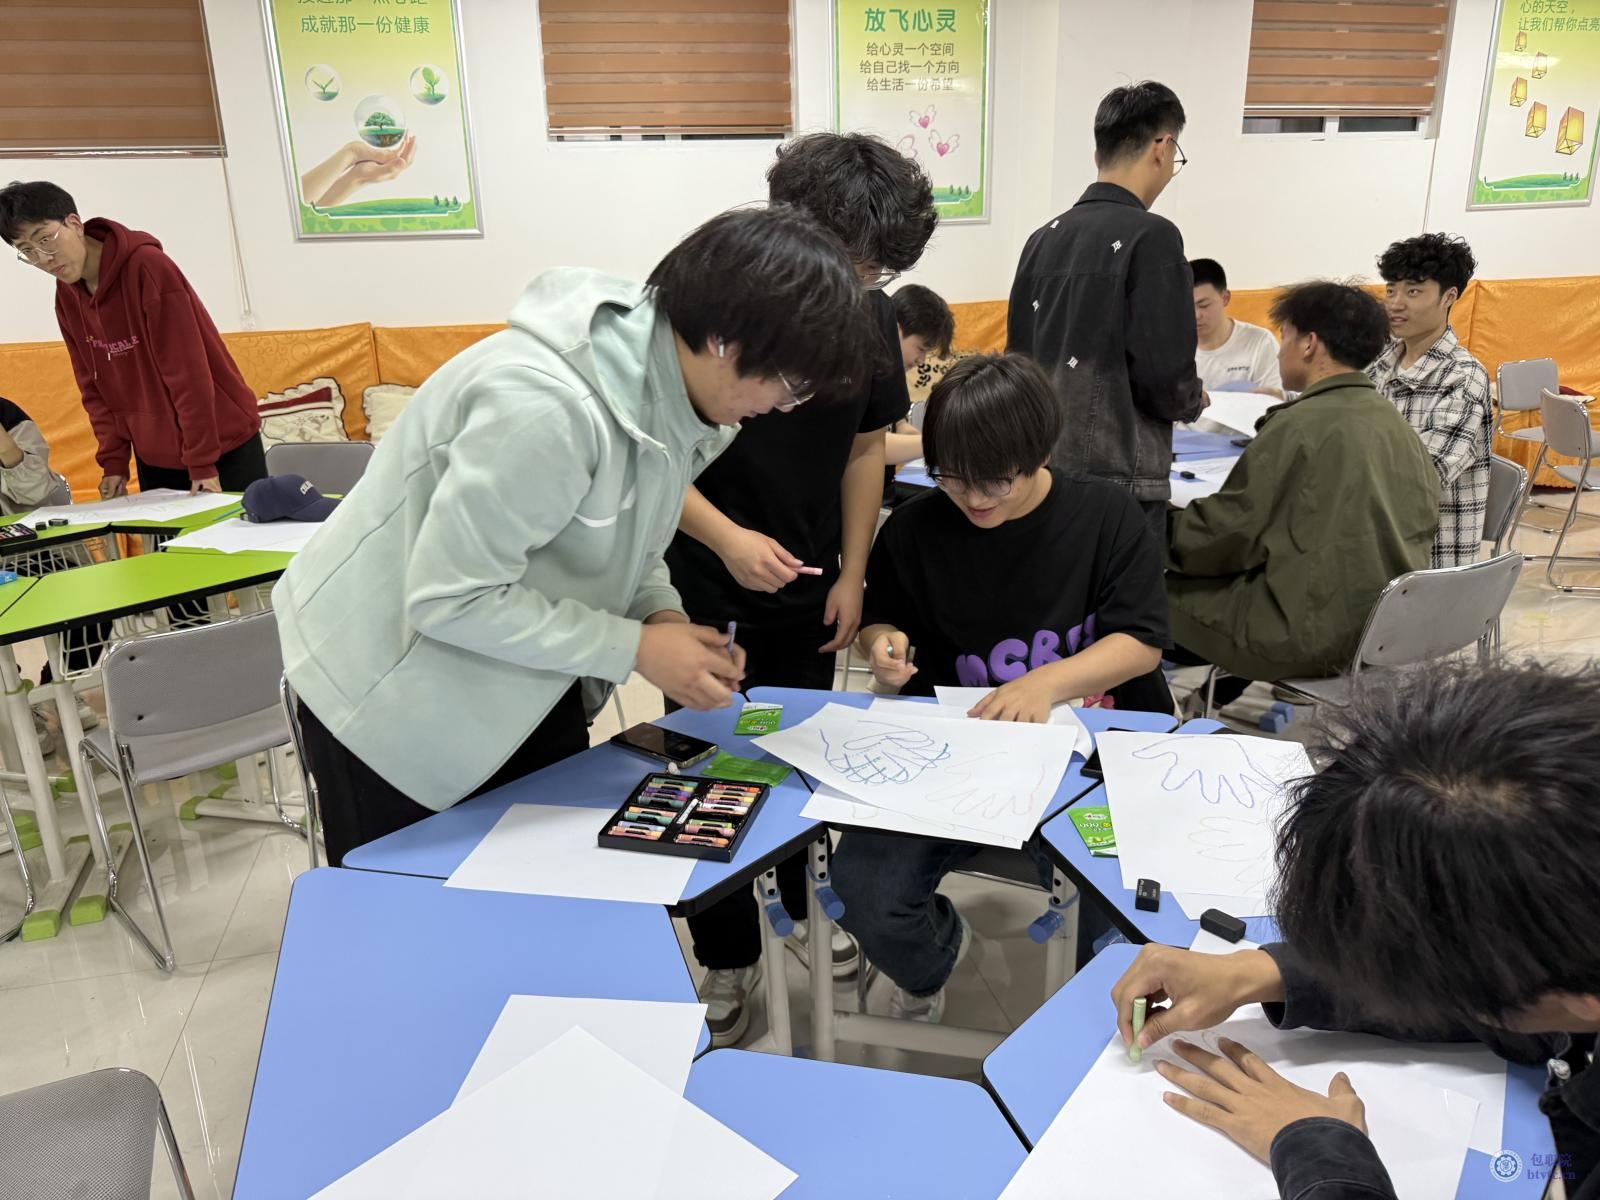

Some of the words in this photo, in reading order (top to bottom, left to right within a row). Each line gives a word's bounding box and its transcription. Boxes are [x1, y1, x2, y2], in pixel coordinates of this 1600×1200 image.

[301, 15, 430, 34] 成就那一份健康
[864, 8, 956, 32] 放飞心灵
[866, 42, 955, 56] 给心灵一个空间
[859, 60, 960, 74] 给自己找一个方向
[866, 77, 954, 92] 给生活一份希望
